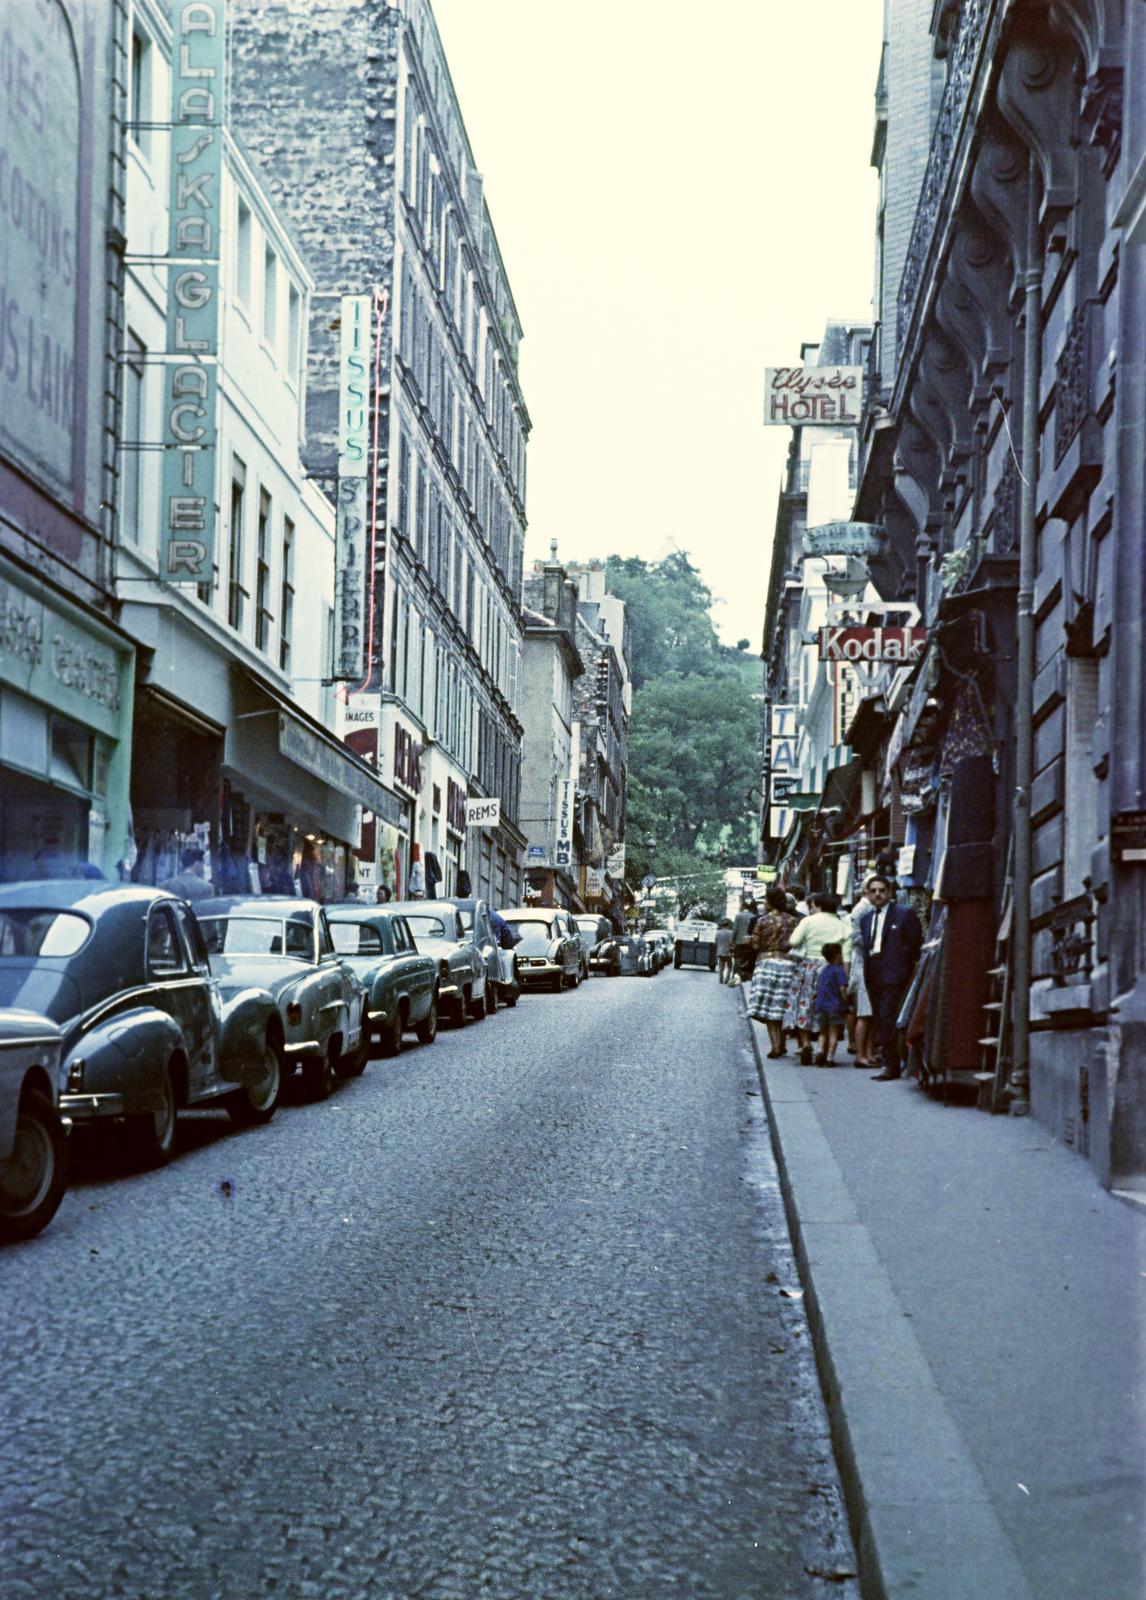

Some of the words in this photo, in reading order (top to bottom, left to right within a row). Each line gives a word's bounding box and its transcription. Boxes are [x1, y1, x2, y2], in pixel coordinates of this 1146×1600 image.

[176, 2, 216, 252] ALASKA
[347, 301, 365, 461] TISSUS
[770, 394, 857, 420] HOTEL
[166, 270, 212, 575] GLACIER
[820, 626, 926, 661] Kodak
[773, 708, 795, 836] TAI
[469, 803, 497, 822] REMS
[561, 781, 570, 838] TISSUS
[556, 840, 570, 865] MB
